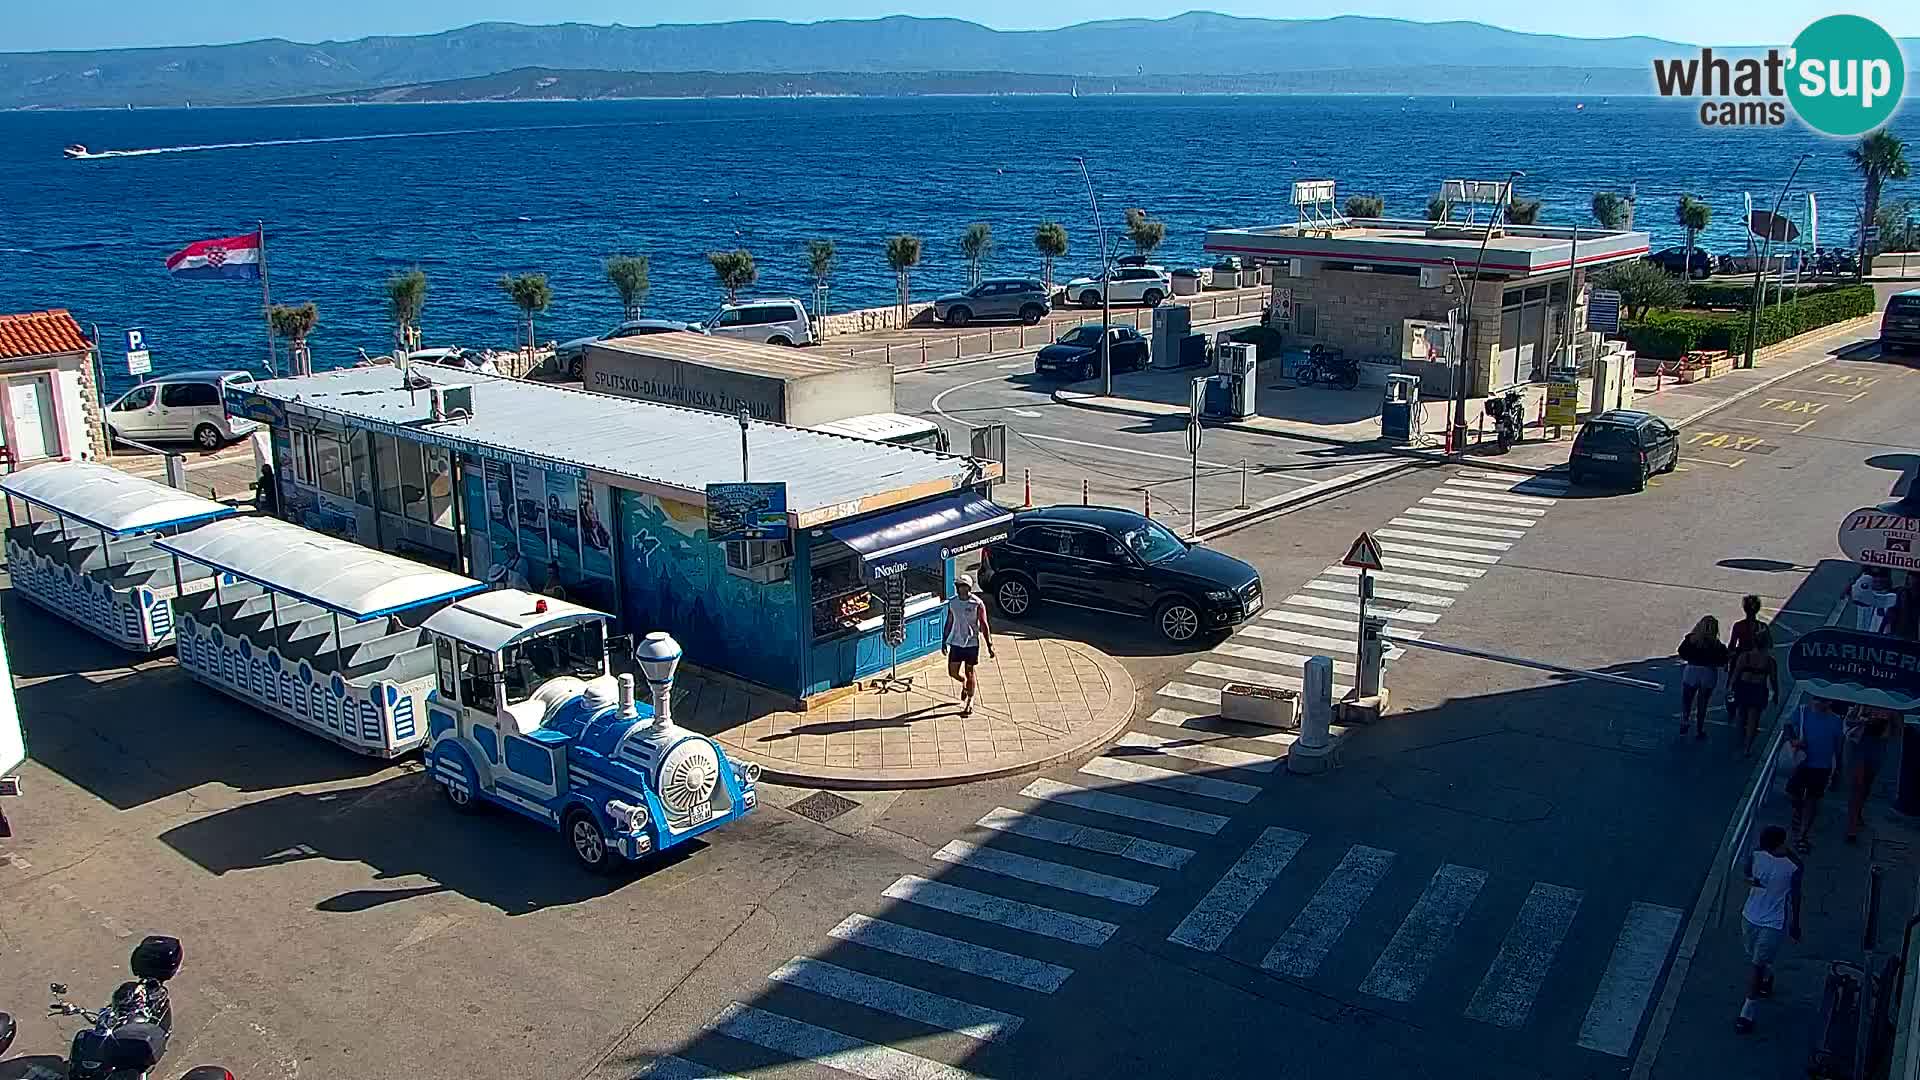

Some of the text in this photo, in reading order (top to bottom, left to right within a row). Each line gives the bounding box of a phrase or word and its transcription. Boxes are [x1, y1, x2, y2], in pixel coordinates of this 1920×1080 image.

[128, 331, 142, 350] P
[594, 371, 717, 409] SPLITSKO-DALMATINSKA
[1816, 374, 1880, 387] TAXI
[1760, 399, 1830, 414] TAXI
[1687, 432, 1764, 451] TAXI
[478, 447, 492, 458] BUS
[493, 450, 526, 465] STATION
[528, 457, 553, 471] TICKET
[555, 463, 582, 477] OFFICE
[1848, 515, 1920, 532] PIZZE
[1801, 642, 1920, 673] MARINER
[1871, 665, 1897, 680] bar
